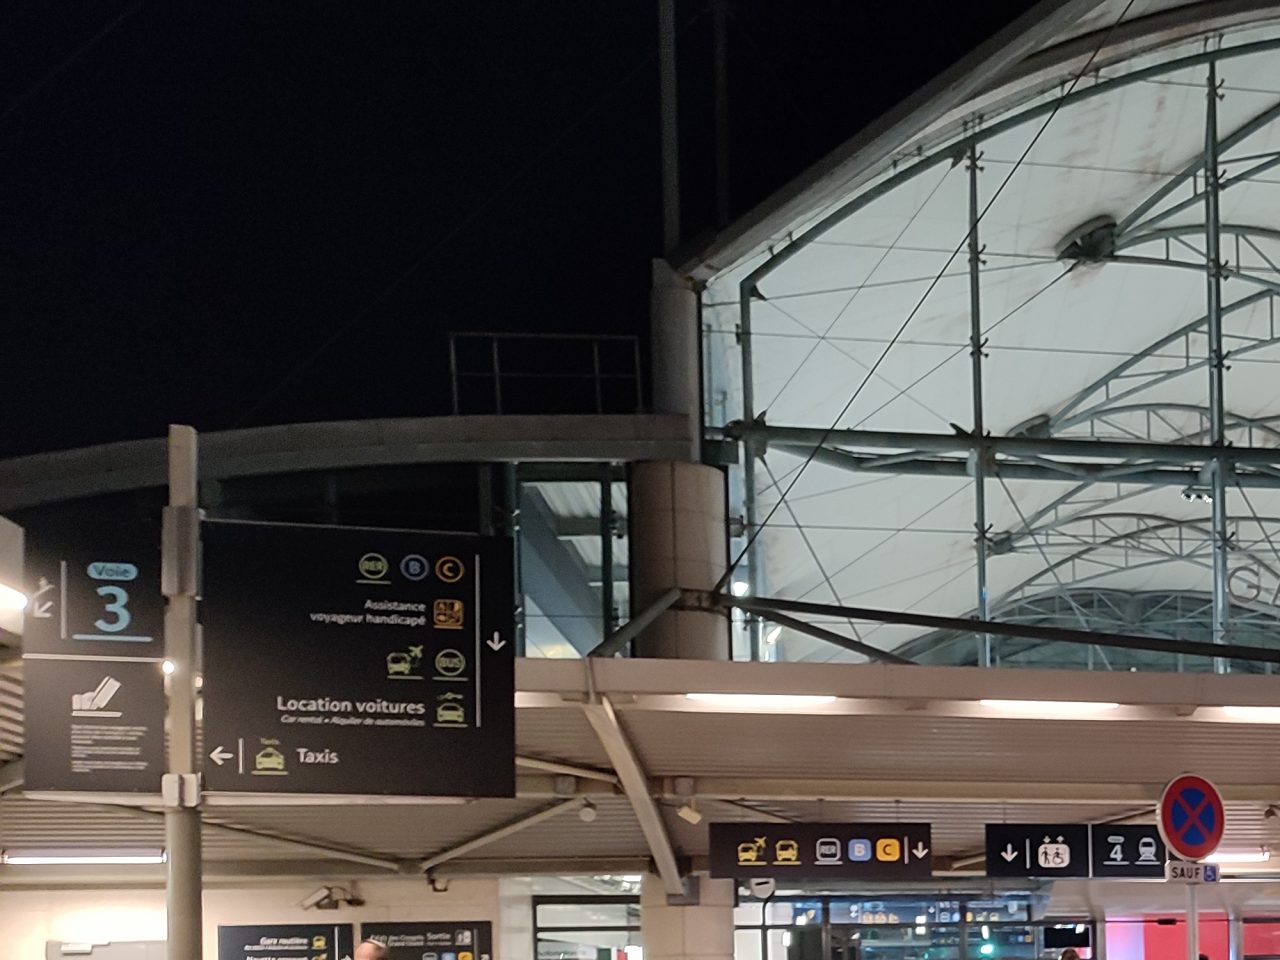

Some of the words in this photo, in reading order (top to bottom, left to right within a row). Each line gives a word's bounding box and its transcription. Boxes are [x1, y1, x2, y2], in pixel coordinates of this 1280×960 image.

[93, 565, 130, 577] Voie
[409, 561, 420, 574] B
[443, 563, 453, 576] C
[94, 585, 131, 632] 3
[364, 600, 426, 612] Assistance
[309, 613, 364, 624] voyageur
[365, 613, 426, 627] handicapé
[438, 657, 461, 668] BUS
[277, 697, 351, 712] Location
[356, 699, 426, 714] voitures
[296, 748, 339, 763] Taxis
[854, 843, 865, 856] B
[883, 844, 893, 856] C
[1110, 844, 1123, 861] 4
[1171, 867, 1201, 878] SAUF
